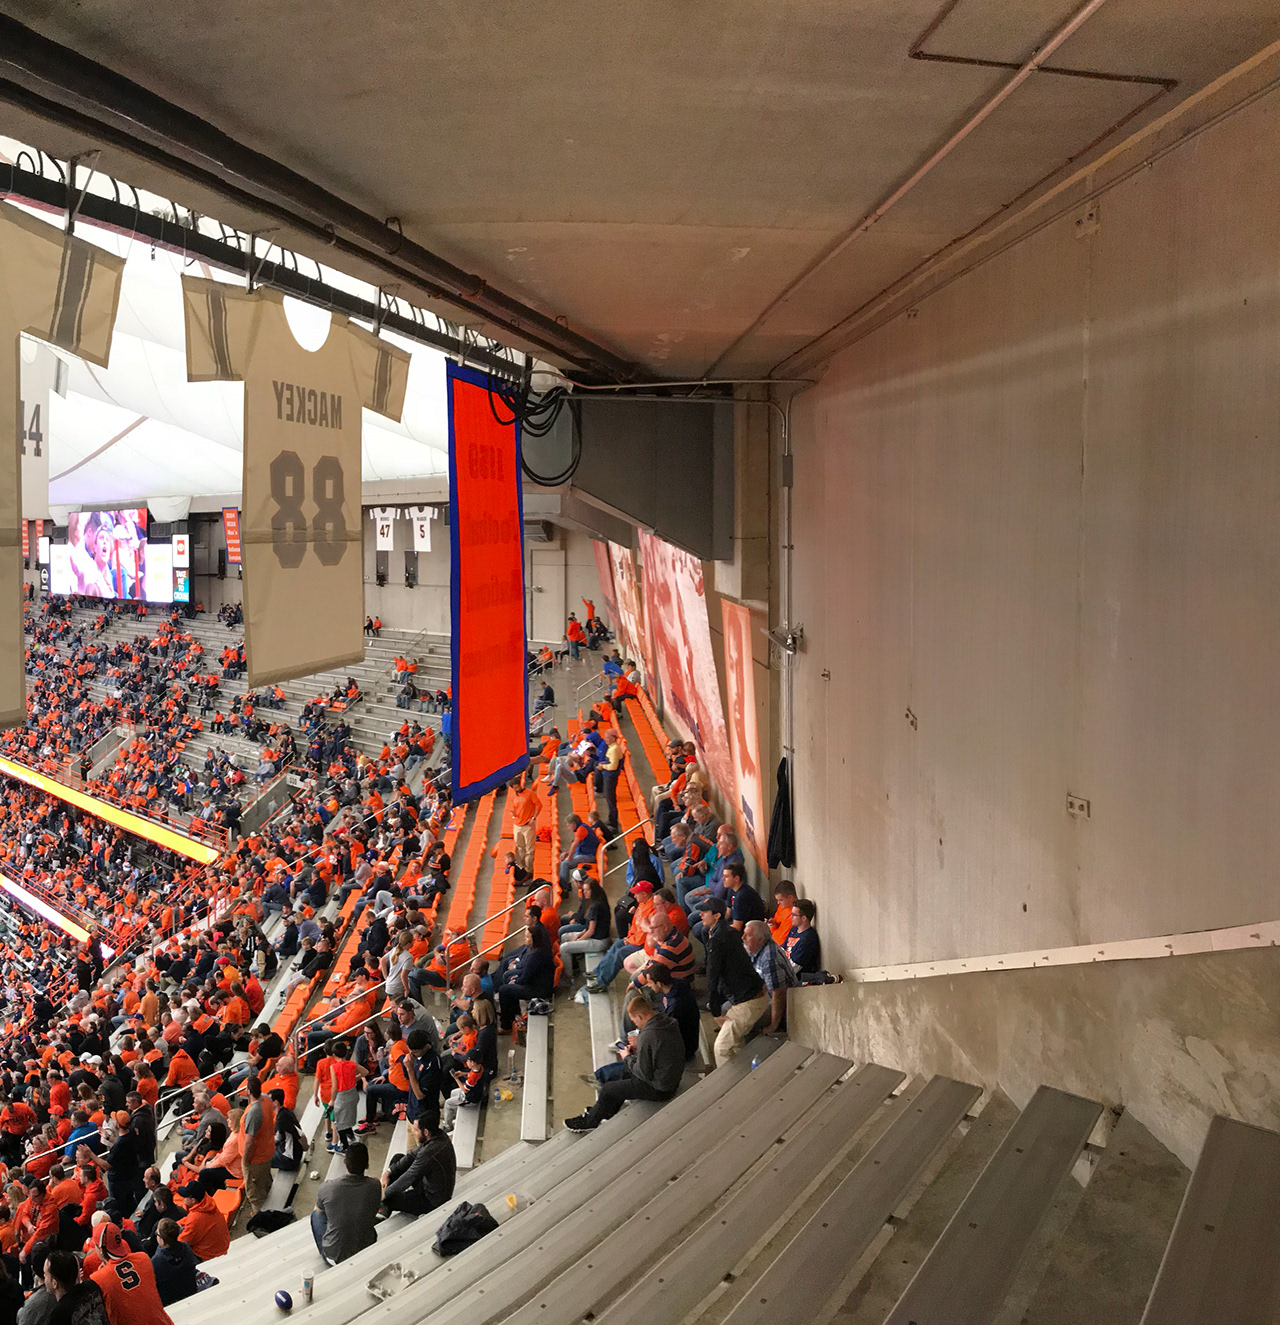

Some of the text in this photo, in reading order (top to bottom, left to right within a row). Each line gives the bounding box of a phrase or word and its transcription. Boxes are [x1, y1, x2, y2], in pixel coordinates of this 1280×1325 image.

[379, 524, 391, 538] 47
[419, 524, 426, 539] 5
[114, 1234, 122, 1244] S
[114, 1260, 141, 1291] S
